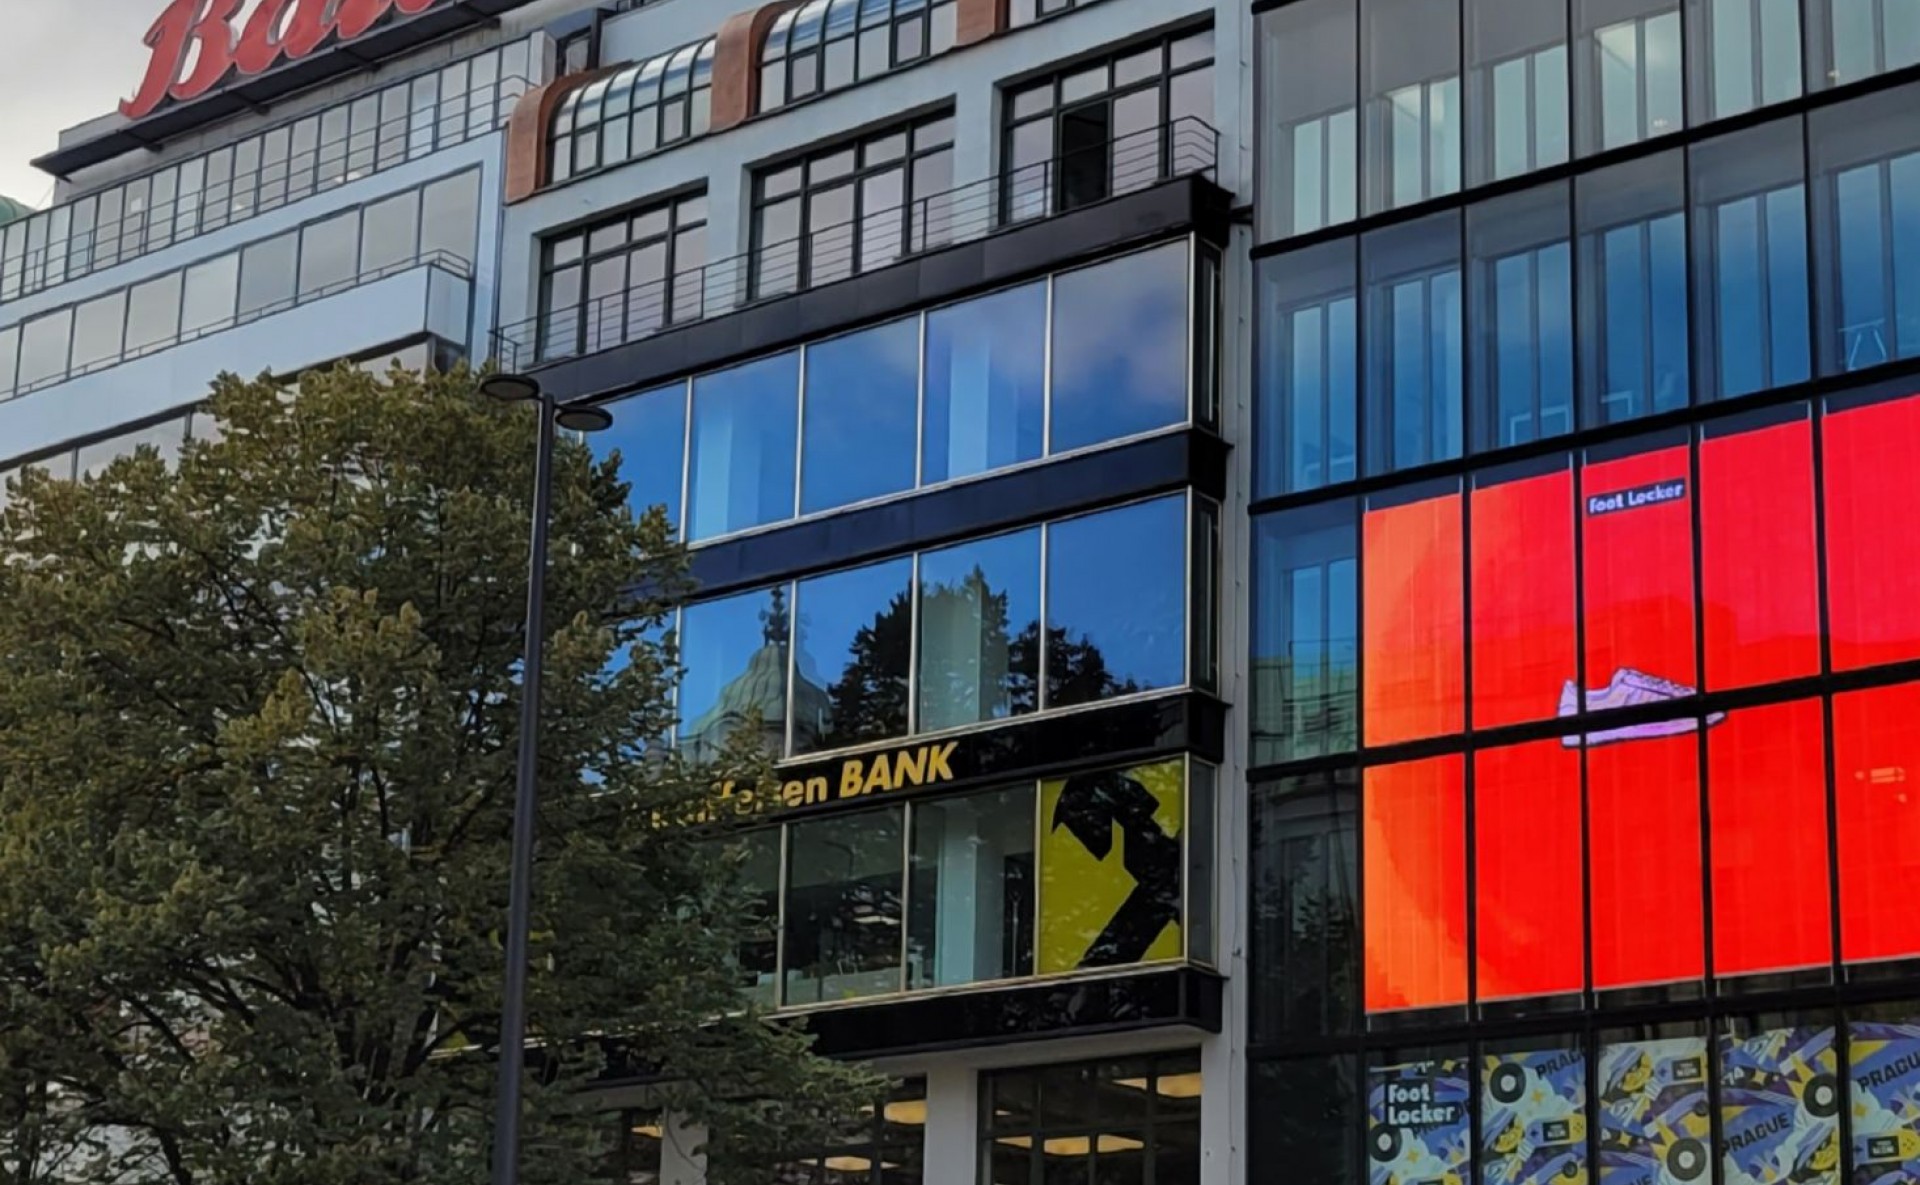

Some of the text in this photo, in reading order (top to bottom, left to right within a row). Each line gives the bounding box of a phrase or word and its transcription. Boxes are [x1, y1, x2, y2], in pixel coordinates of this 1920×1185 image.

[1589, 484, 1683, 514] Foot Locker
[839, 741, 959, 798] BANK
[1388, 1082, 1431, 1103] Foot
[1388, 1103, 1456, 1125] Locker
[1721, 1112, 1790, 1158] PRAGUE
